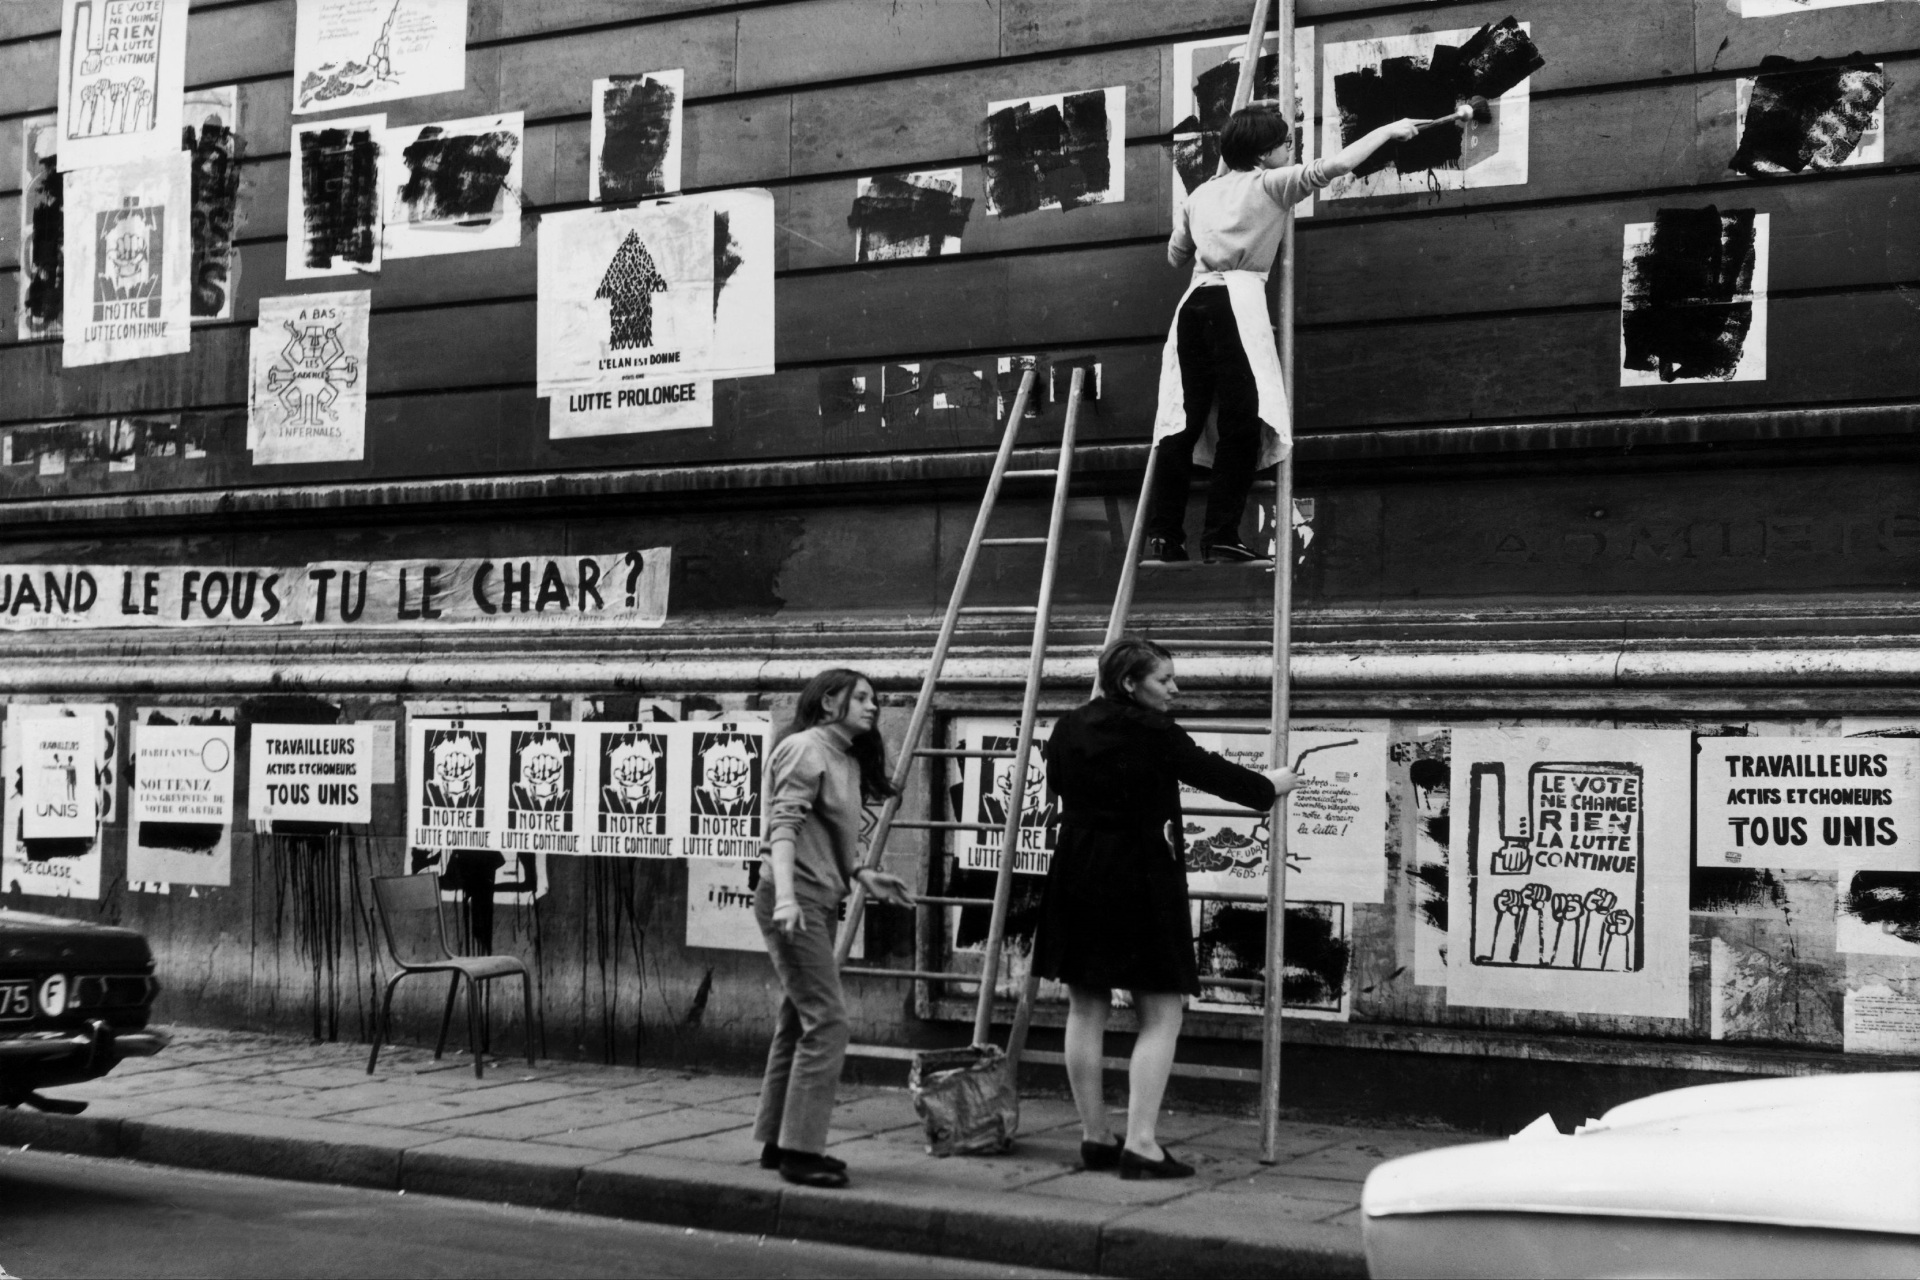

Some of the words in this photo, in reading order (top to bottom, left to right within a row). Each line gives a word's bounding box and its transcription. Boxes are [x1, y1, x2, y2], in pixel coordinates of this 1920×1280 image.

[111, 2, 123, 15] LE
[108, 25, 156, 40] RIEN
[105, 42, 118, 53] LA
[123, 39, 154, 52] LUTTE
[104, 52, 156, 66] CONTINUE
[104, 301, 147, 321] NOTRE
[299, 309, 307, 320] A
[313, 308, 336, 320] BAS
[305, 359, 320, 369] LES
[598, 358, 632, 371] L'ELAN
[634, 358, 648, 367] EST
[650, 351, 681, 365] DONNE
[293, 371, 330, 380] CADENCES
[569, 391, 612, 412] LUTTE
[618, 383, 696, 409] PROLONGEE
[278, 426, 342, 438] INFERNALES
[121, 571, 160, 615] LE
[180, 570, 281, 621] FOUS
[309, 569, 367, 622] TU
[397, 566, 442, 620] LE
[266, 738, 355, 755] TRAVAILLEURS
[266, 763, 296, 776] ACTIFS
[299, 763, 310, 775] ET
[311, 763, 357, 776] CHOMEURS
[1725, 754, 1888, 778] TRAVAILLEURS
[140, 778, 211, 791] SOUTENEZ
[1541, 775, 1566, 794] LE
[1571, 776, 1638, 796] VOTE
[266, 784, 310, 805] TOUS
[318, 784, 359, 806] UNIS
[1540, 794, 1568, 809] NE
[1571, 794, 1637, 813] CHANGE
[1726, 788, 1782, 806] ACTIFS
[1786, 788, 1808, 804] ET
[1809, 788, 1893, 806] CHOMEURS
[36, 803, 78, 818] UNIS
[432, 810, 472, 828] NOTRE
[519, 813, 560, 832] NOTRE
[610, 816, 654, 835] NOTRE
[702, 818, 747, 837] NOTRE
[1312, 824, 1338, 836] lutte
[1539, 810, 1632, 835] RIEN
[1728, 816, 1808, 847] TOUS
[1823, 816, 1898, 847] UNIS
[415, 828, 442, 846] LUTTE
[446, 829, 491, 848] CONTINUE
[501, 831, 530, 850] LUTTE
[533, 833, 580, 852] CONTINUE
[591, 835, 621, 854] LUTTE
[624, 836, 674, 856] CONTINUE
[682, 836, 713, 856] LUTTE
[717, 838, 761, 858] CONTINU
[991, 829, 1042, 850] NRE
[1536, 832, 1564, 849] LA
[1571, 834, 1632, 852] LUTTE
[36, 862, 71, 878] CLASSE
[1014, 851, 1052, 872] ONTIN
[1535, 851, 1637, 874] CONTINUE
[0, 985, 30, 1014] 75
[46, 980, 62, 1008] F
